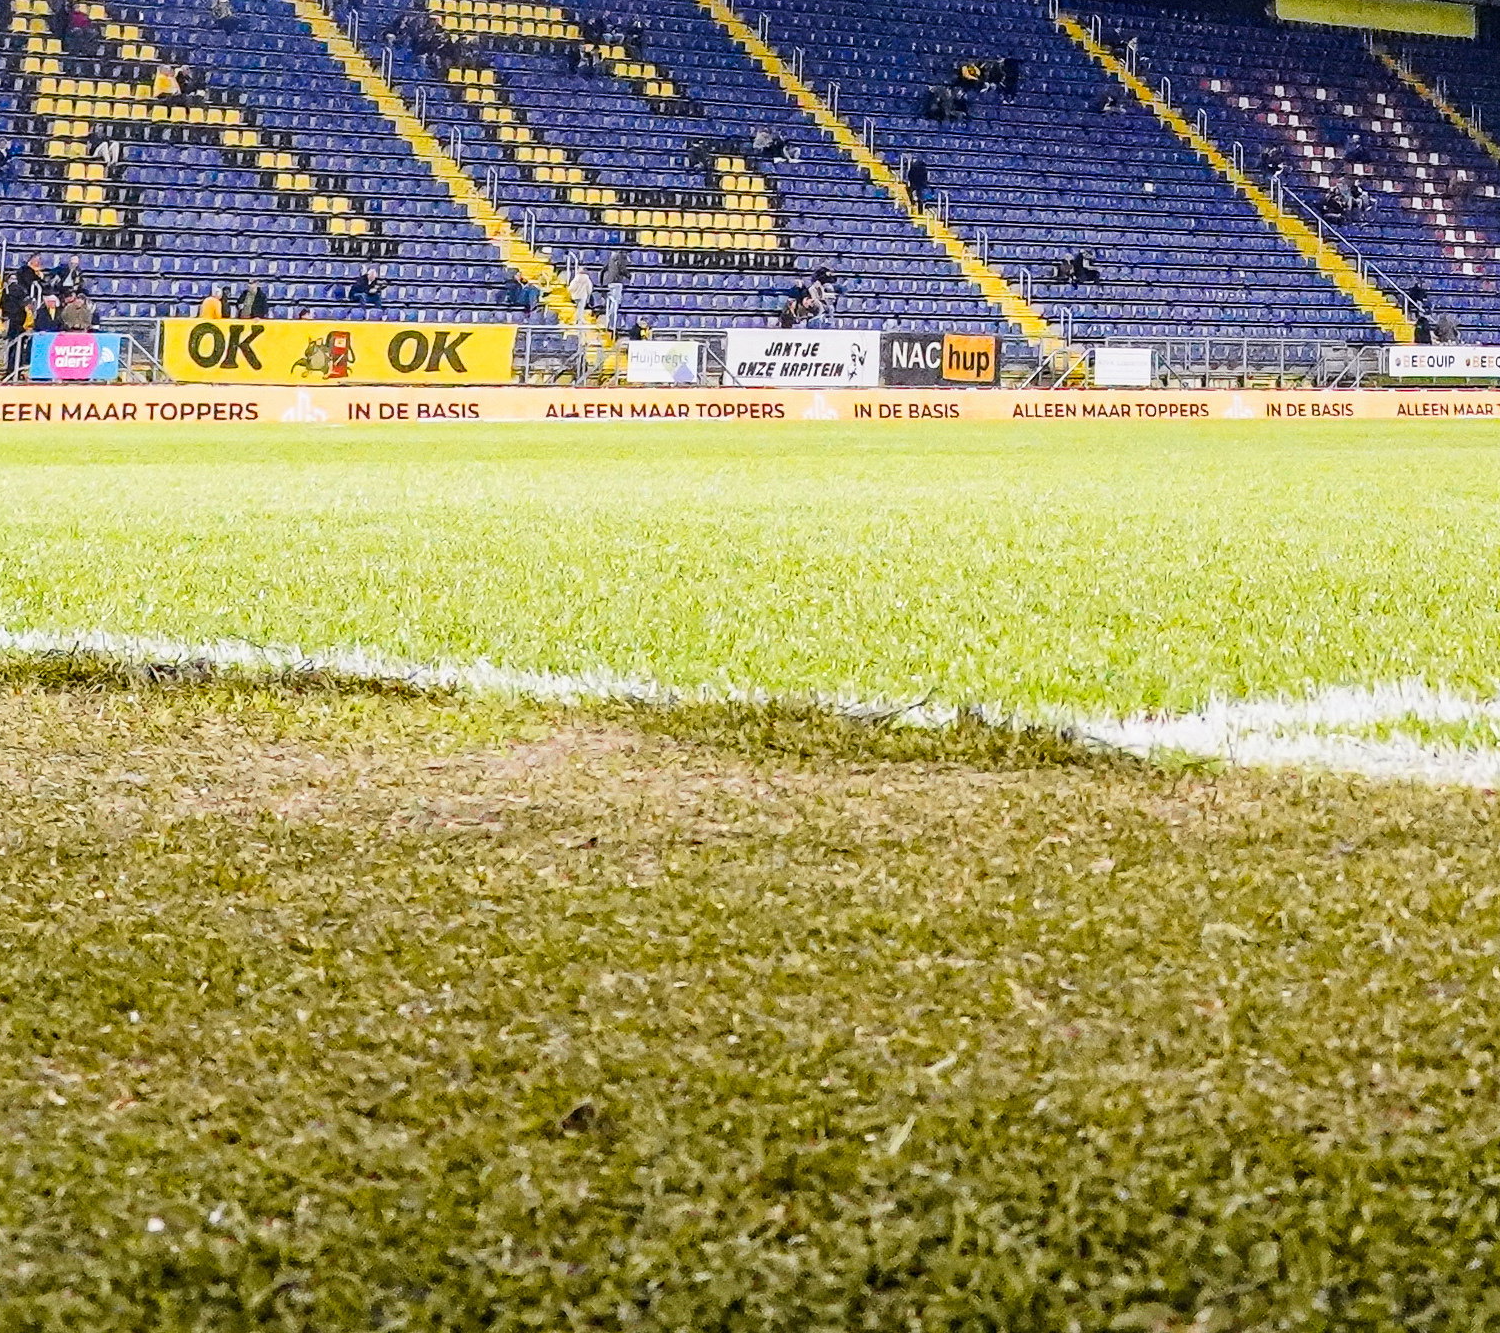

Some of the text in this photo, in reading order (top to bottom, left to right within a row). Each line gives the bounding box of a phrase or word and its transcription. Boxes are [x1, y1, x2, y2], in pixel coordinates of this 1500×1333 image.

[187, 322, 266, 371] OK
[387, 330, 473, 374] OK
[54, 353, 92, 368] alert
[891, 340, 941, 370] NAC
[949, 344, 991, 378] hup
[737, 362, 845, 378] ONZE KAPITEIN
[59, 402, 138, 421] MAAR
[148, 402, 260, 421] TOPPERS
[348, 402, 481, 421] IN DE BASIS
[545, 403, 786, 419] ALLEEN MAAR TOPPERS
[854, 403, 960, 419] IN DE BASIS
[1012, 403, 1210, 418] ALLEEN MAAR TOPPERS
[1266, 402, 1355, 418] IN DE BASIS
[1397, 402, 1449, 417] ALLEEN
[1453, 402, 1494, 417] MAAR
